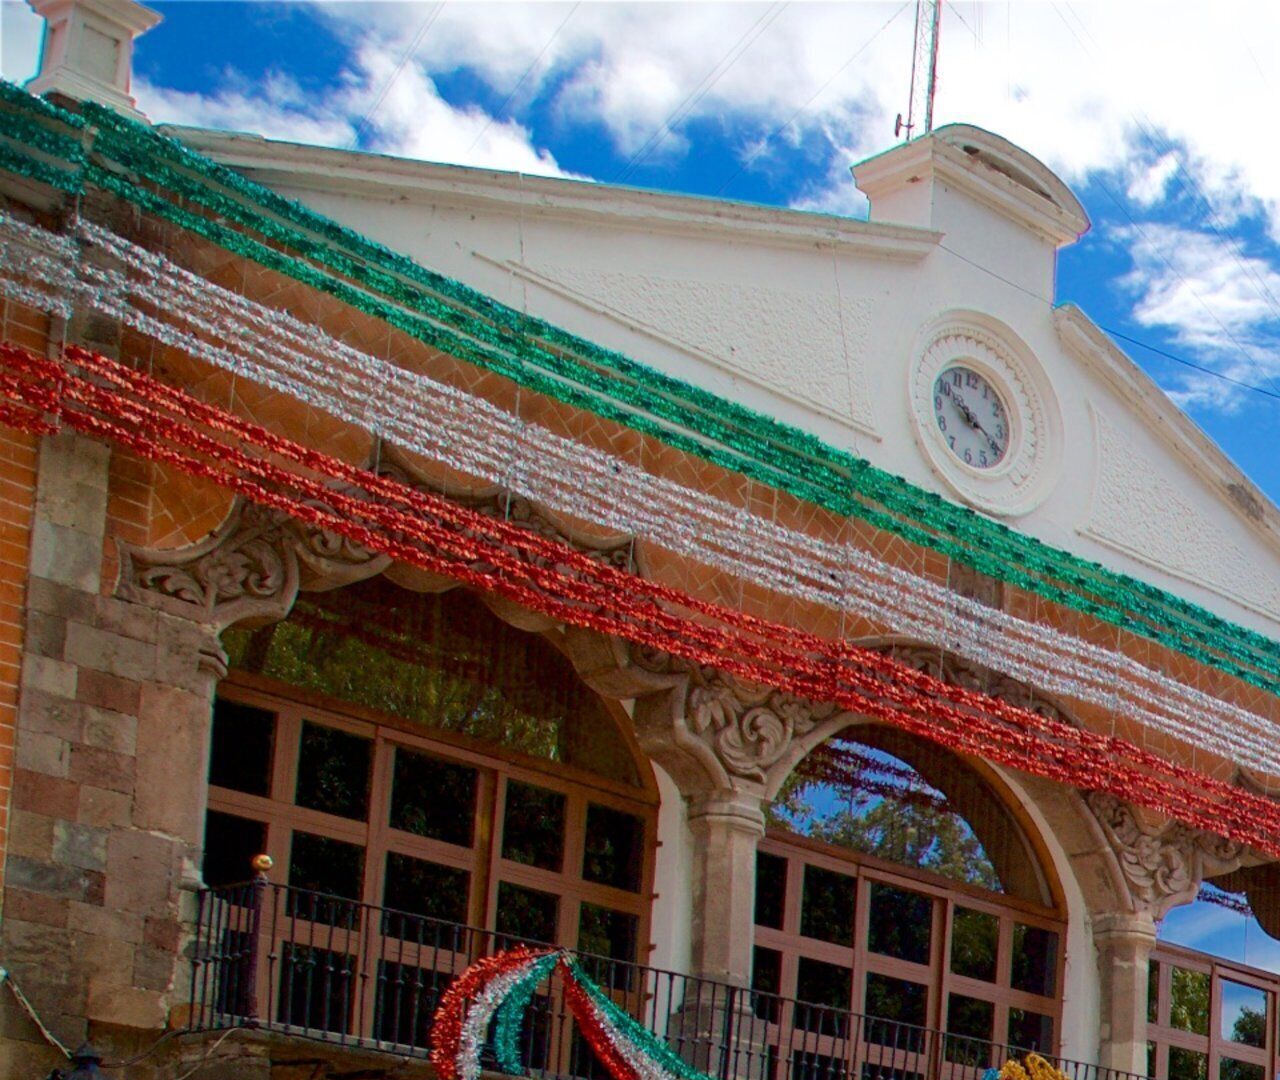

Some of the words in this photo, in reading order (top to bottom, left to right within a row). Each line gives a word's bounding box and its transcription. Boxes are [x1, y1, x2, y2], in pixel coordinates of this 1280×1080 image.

[954, 372, 962, 388] 11
[966, 373, 978, 389] 12
[938, 380, 951, 397] 10
[935, 396, 942, 410] 9
[992, 402, 999, 417] 2
[938, 416, 947, 431] 8
[996, 424, 1003, 439] 3
[964, 448, 972, 463] 6
[979, 449, 987, 466] 5
